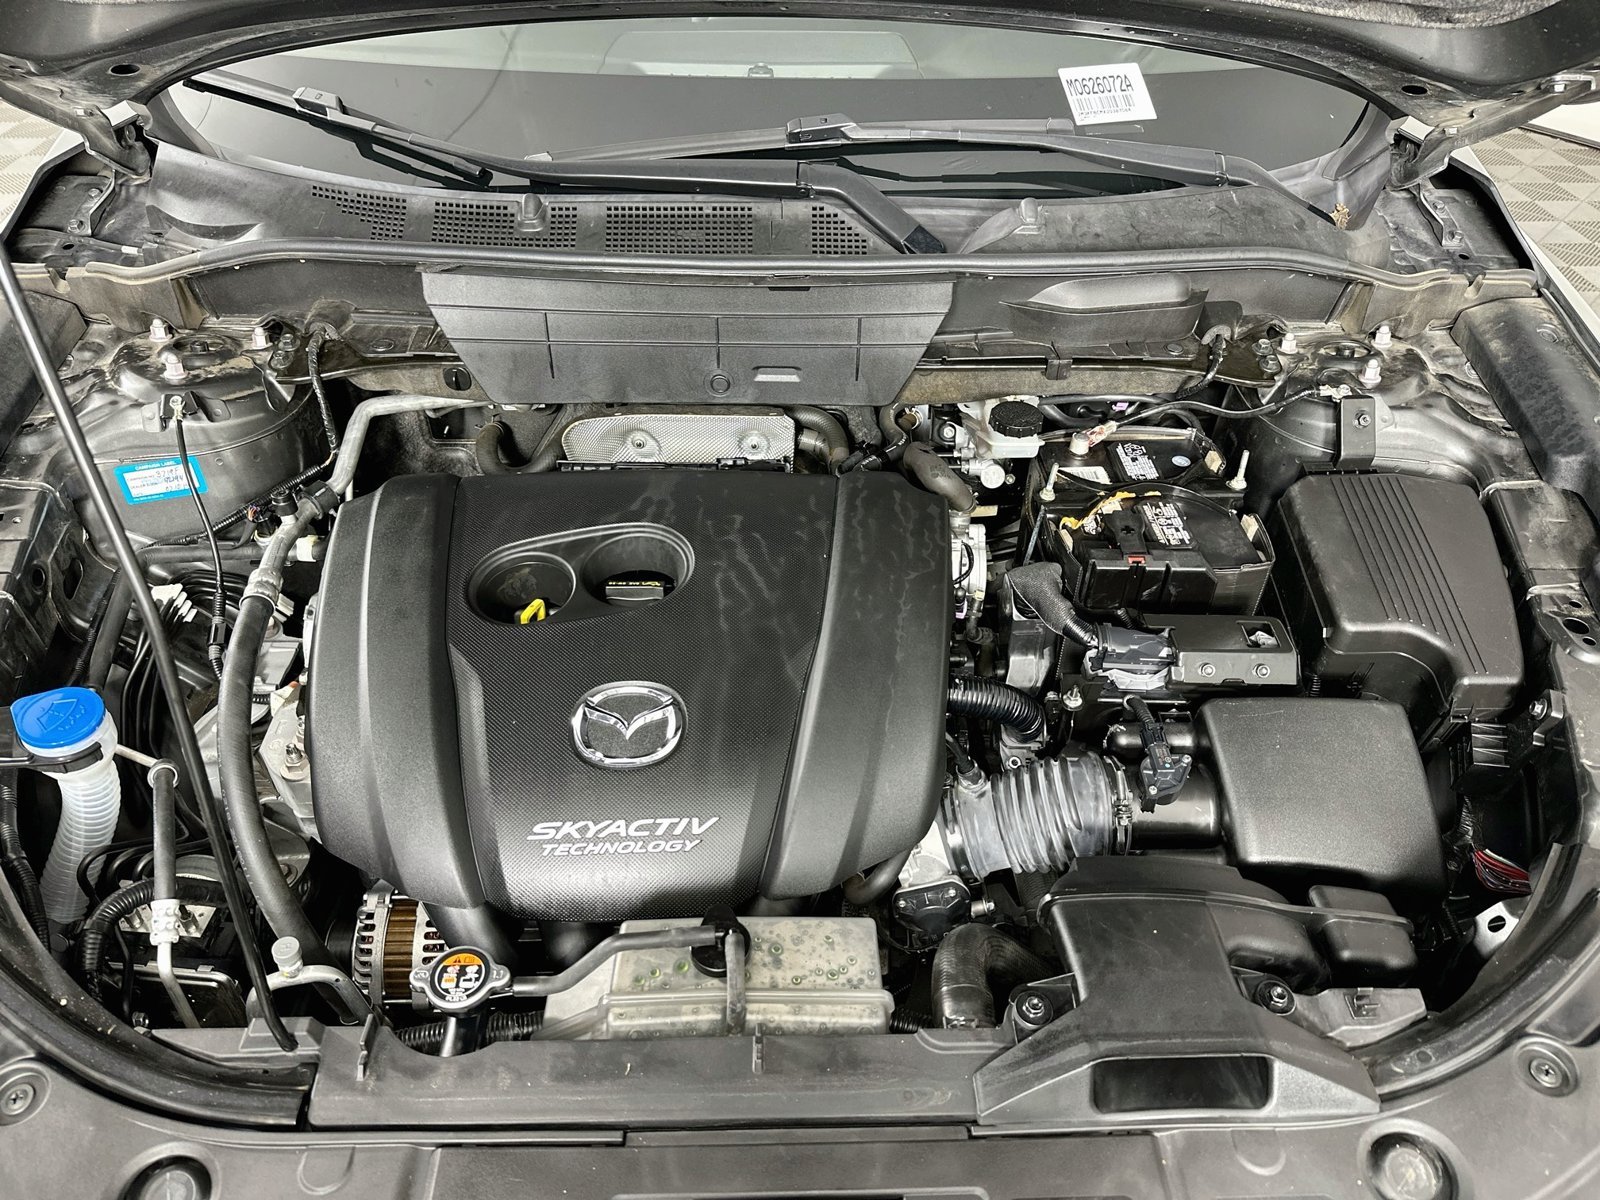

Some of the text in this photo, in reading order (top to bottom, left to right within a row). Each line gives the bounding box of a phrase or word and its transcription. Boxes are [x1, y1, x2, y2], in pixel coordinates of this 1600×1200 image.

[1065, 74, 1134, 97] M0626072A
[526, 817, 720, 841] SKYACTIV
[542, 840, 702, 857] TECHNOLOGY
